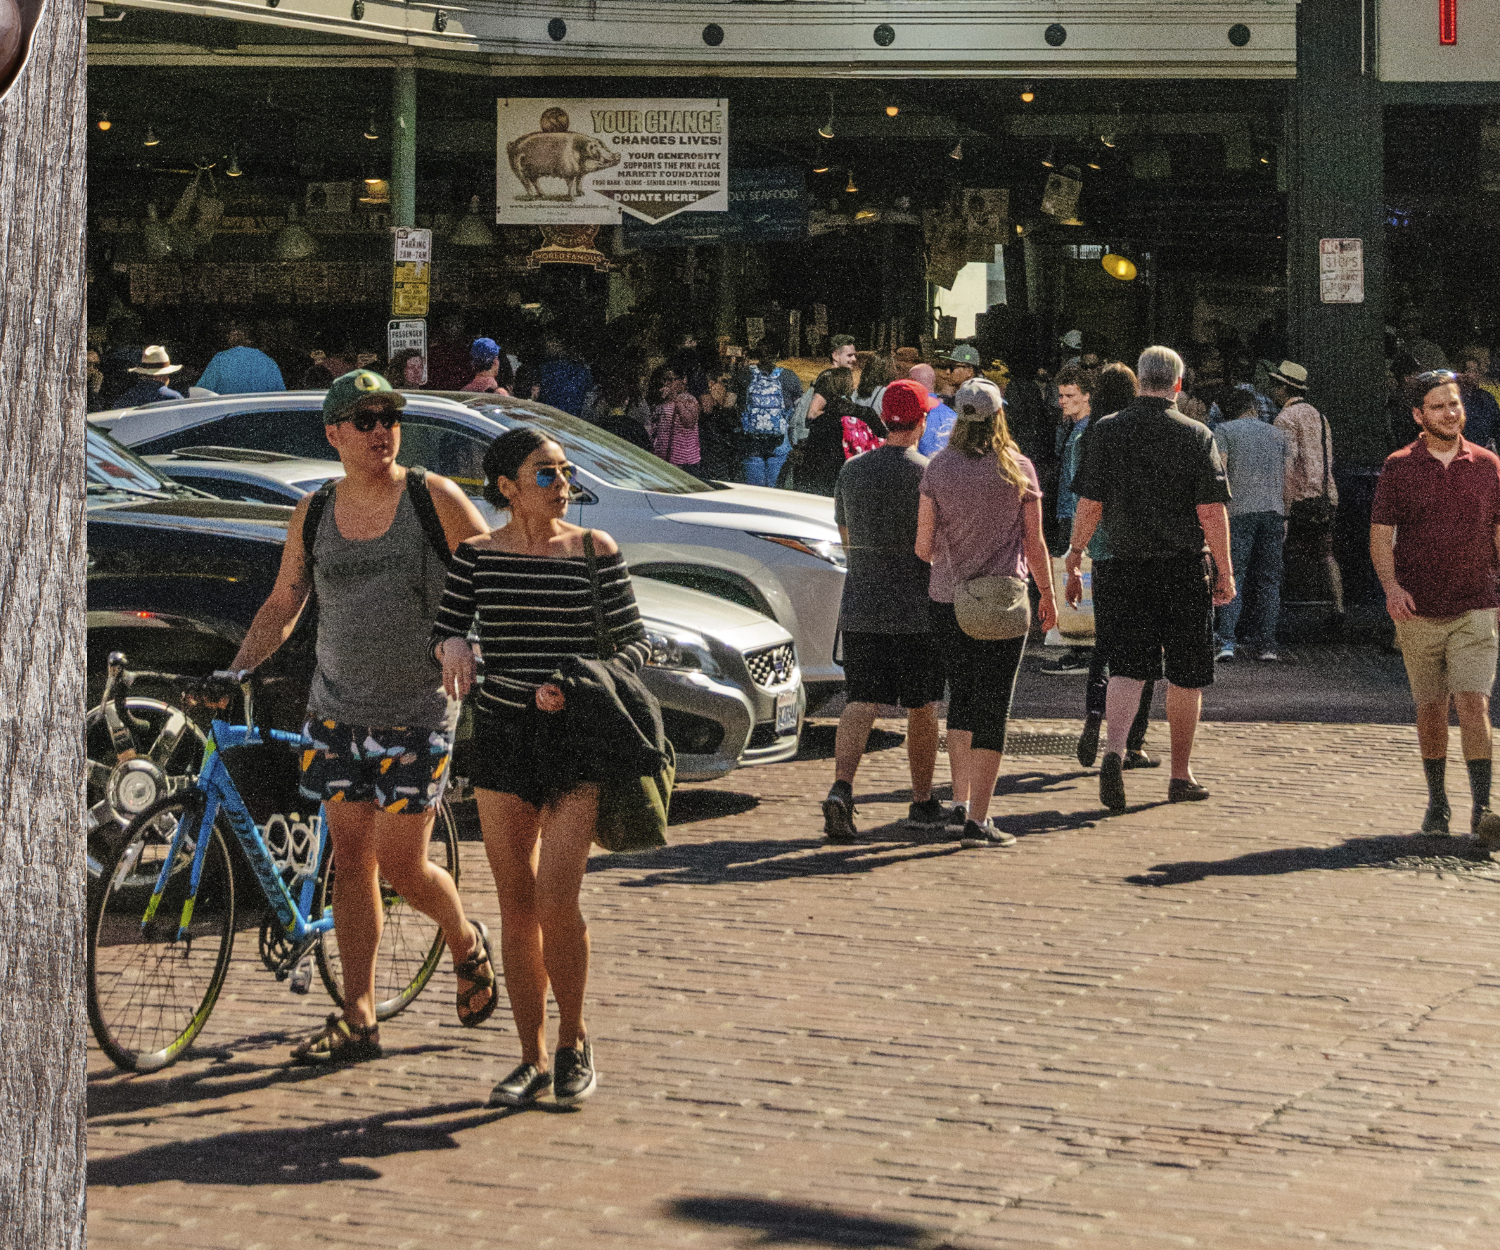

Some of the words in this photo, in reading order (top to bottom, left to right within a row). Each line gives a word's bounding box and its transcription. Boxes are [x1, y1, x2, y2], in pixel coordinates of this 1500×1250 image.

[590, 109, 643, 134] YOUR
[644, 109, 722, 134] CHANGE
[611, 135, 676, 145] CHANGES
[678, 135, 722, 145] LIVES!
[628, 152, 655, 160] YOUR
[657, 152, 722, 160] GENEROSITY
[623, 161, 662, 169] SUPPORTS
[664, 161, 678, 169] THE
[680, 161, 696, 169] PIKE
[697, 161, 720, 169] PLACE
[613, 193, 662, 202] DONATE
[664, 193, 699, 202] HERE!
[400, 240, 427, 249] PARKING
